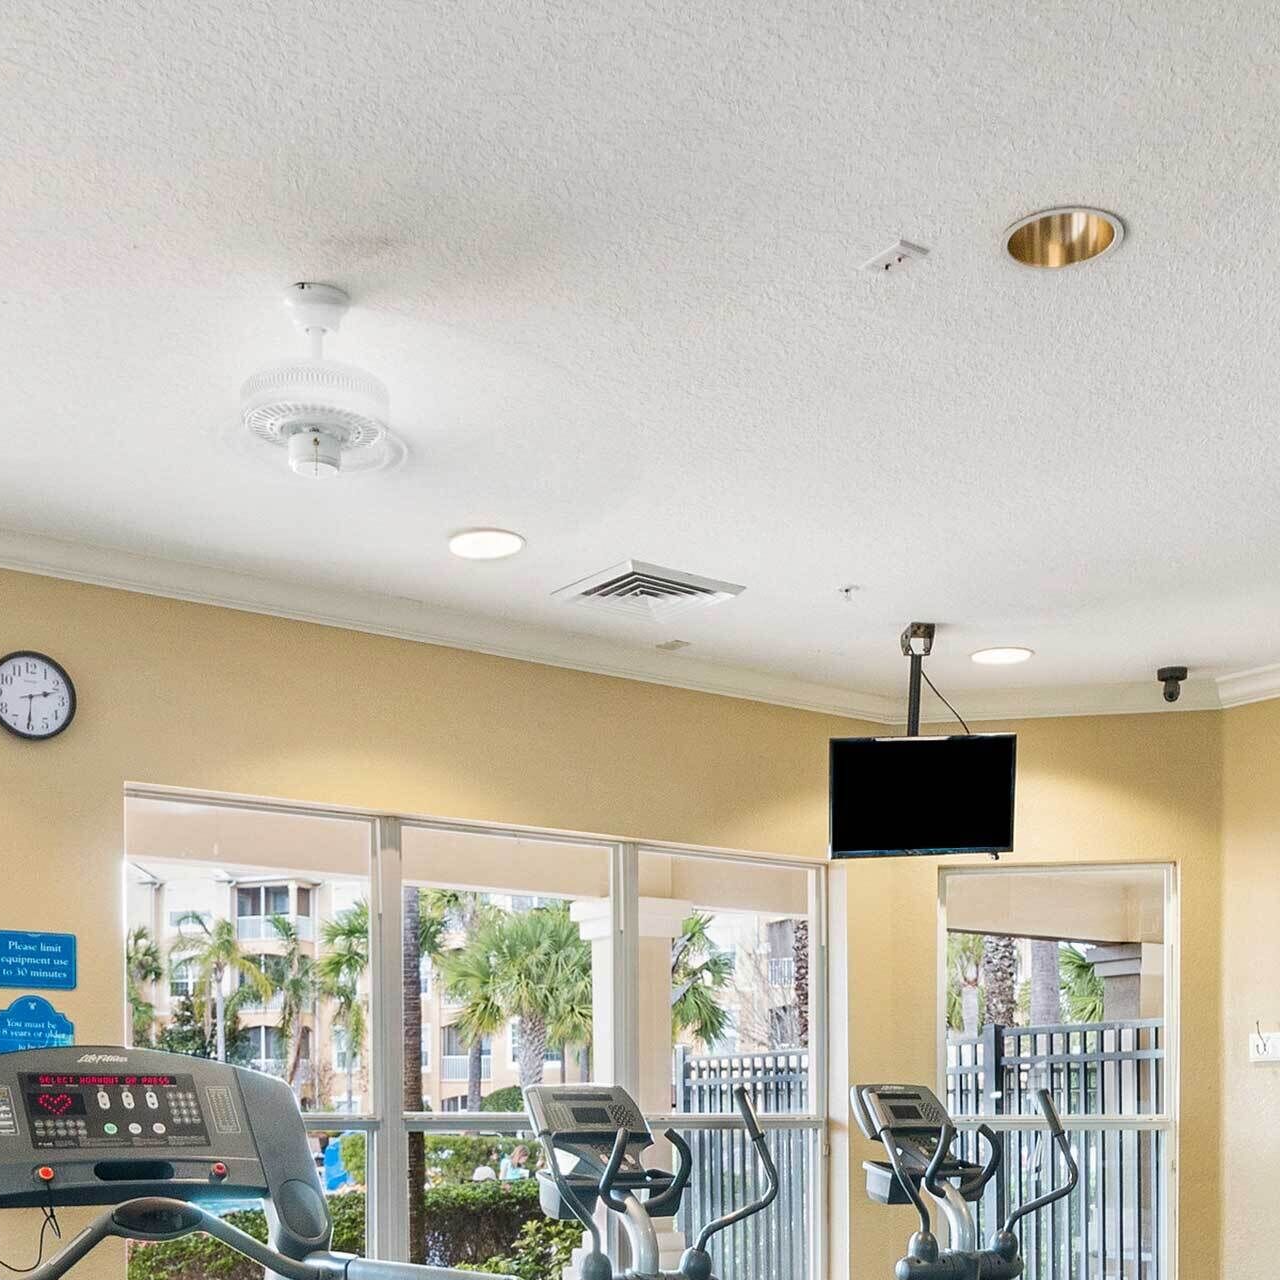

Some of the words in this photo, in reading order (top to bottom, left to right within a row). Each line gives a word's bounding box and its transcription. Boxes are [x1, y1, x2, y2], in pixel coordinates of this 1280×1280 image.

[12, 664, 22, 677] 11
[25, 662, 37, 675] 12
[43, 668, 48, 680] 1
[0, 673, 13, 685] 10
[52, 680, 60, 691] 2
[58, 695, 65, 707] 3
[0, 702, 8, 714] 8
[42, 717, 49, 729] 5
[8, 941, 37, 951] Please
[40, 943, 61, 952] limit
[1, 956, 50, 965] equipment
[17, 968, 28, 976] 30
[30, 969, 67, 978] minutes
[7, 1018, 22, 1027] You
[48, 1021, 56, 1029] be
[40, 1075, 75, 1085] SELECT
